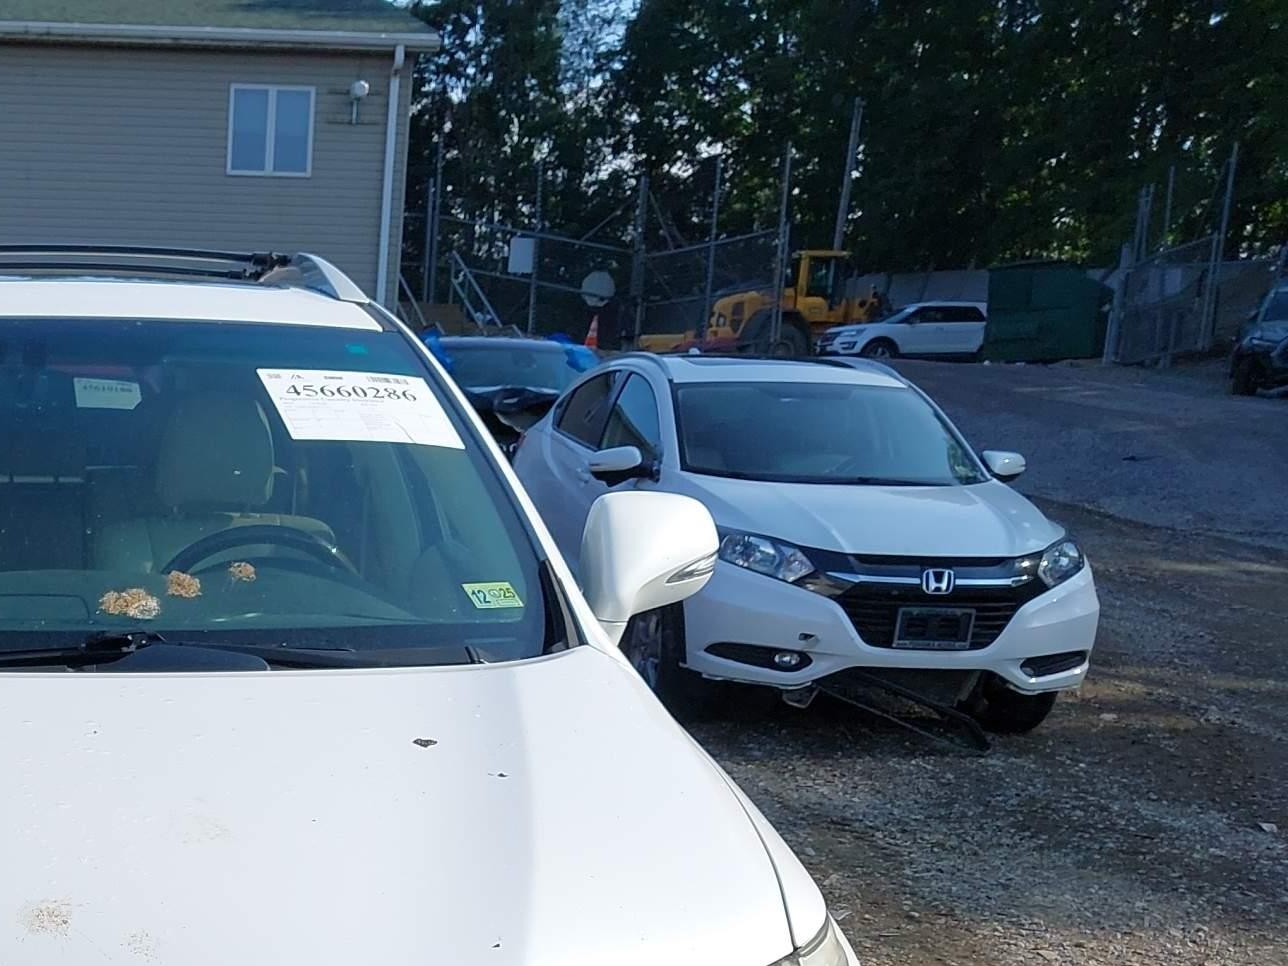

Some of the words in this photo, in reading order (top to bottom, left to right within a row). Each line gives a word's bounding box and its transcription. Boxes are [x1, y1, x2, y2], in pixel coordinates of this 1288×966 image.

[286, 384, 417, 402] 45660286
[471, 589, 491, 604] 12
[499, 587, 516, 599] 25
